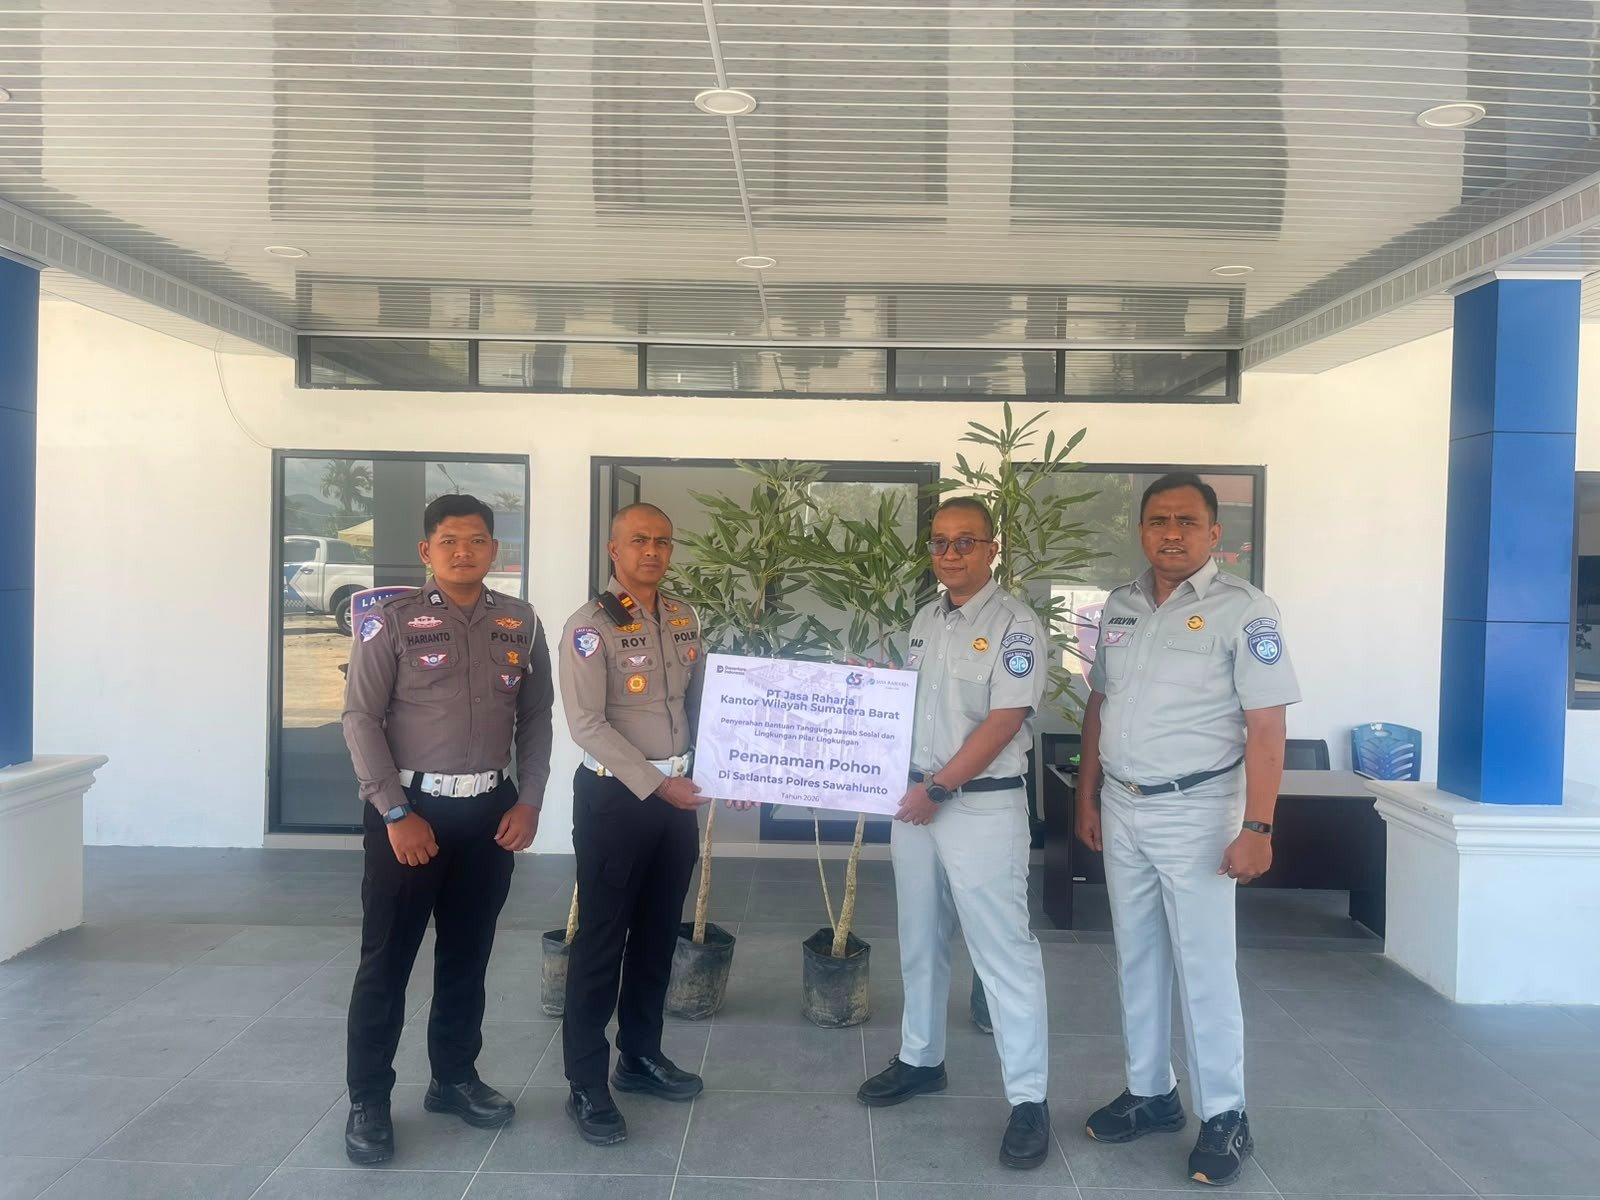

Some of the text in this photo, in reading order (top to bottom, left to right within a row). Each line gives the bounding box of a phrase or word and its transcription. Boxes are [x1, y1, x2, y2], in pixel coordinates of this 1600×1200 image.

[1108, 617, 1138, 626] KELVIN
[407, 632, 450, 646] HARIANTO
[491, 632, 528, 644] POLRI
[621, 637, 647, 649] ROY
[674, 631, 697, 643] POLRI
[766, 689, 855, 707] PT Jasa Raharja
[720, 695, 900, 720] Kantor Wilayah Sumatera Barat
[720, 717, 762, 727] Penyerahan
[764, 722, 795, 730] Bantuan
[797, 724, 832, 734] Tanggung
[834, 728, 857, 736] Jawab
[859, 730, 880, 738] Sosial
[754, 730, 859, 746] Lingkungan Pilar Lingkungan
[729, 749, 881, 775] Penanaman Pohon
[718, 770, 888, 795] Di Satlantas Polres Sawahlunto
[781, 792, 802, 800] Tahun
